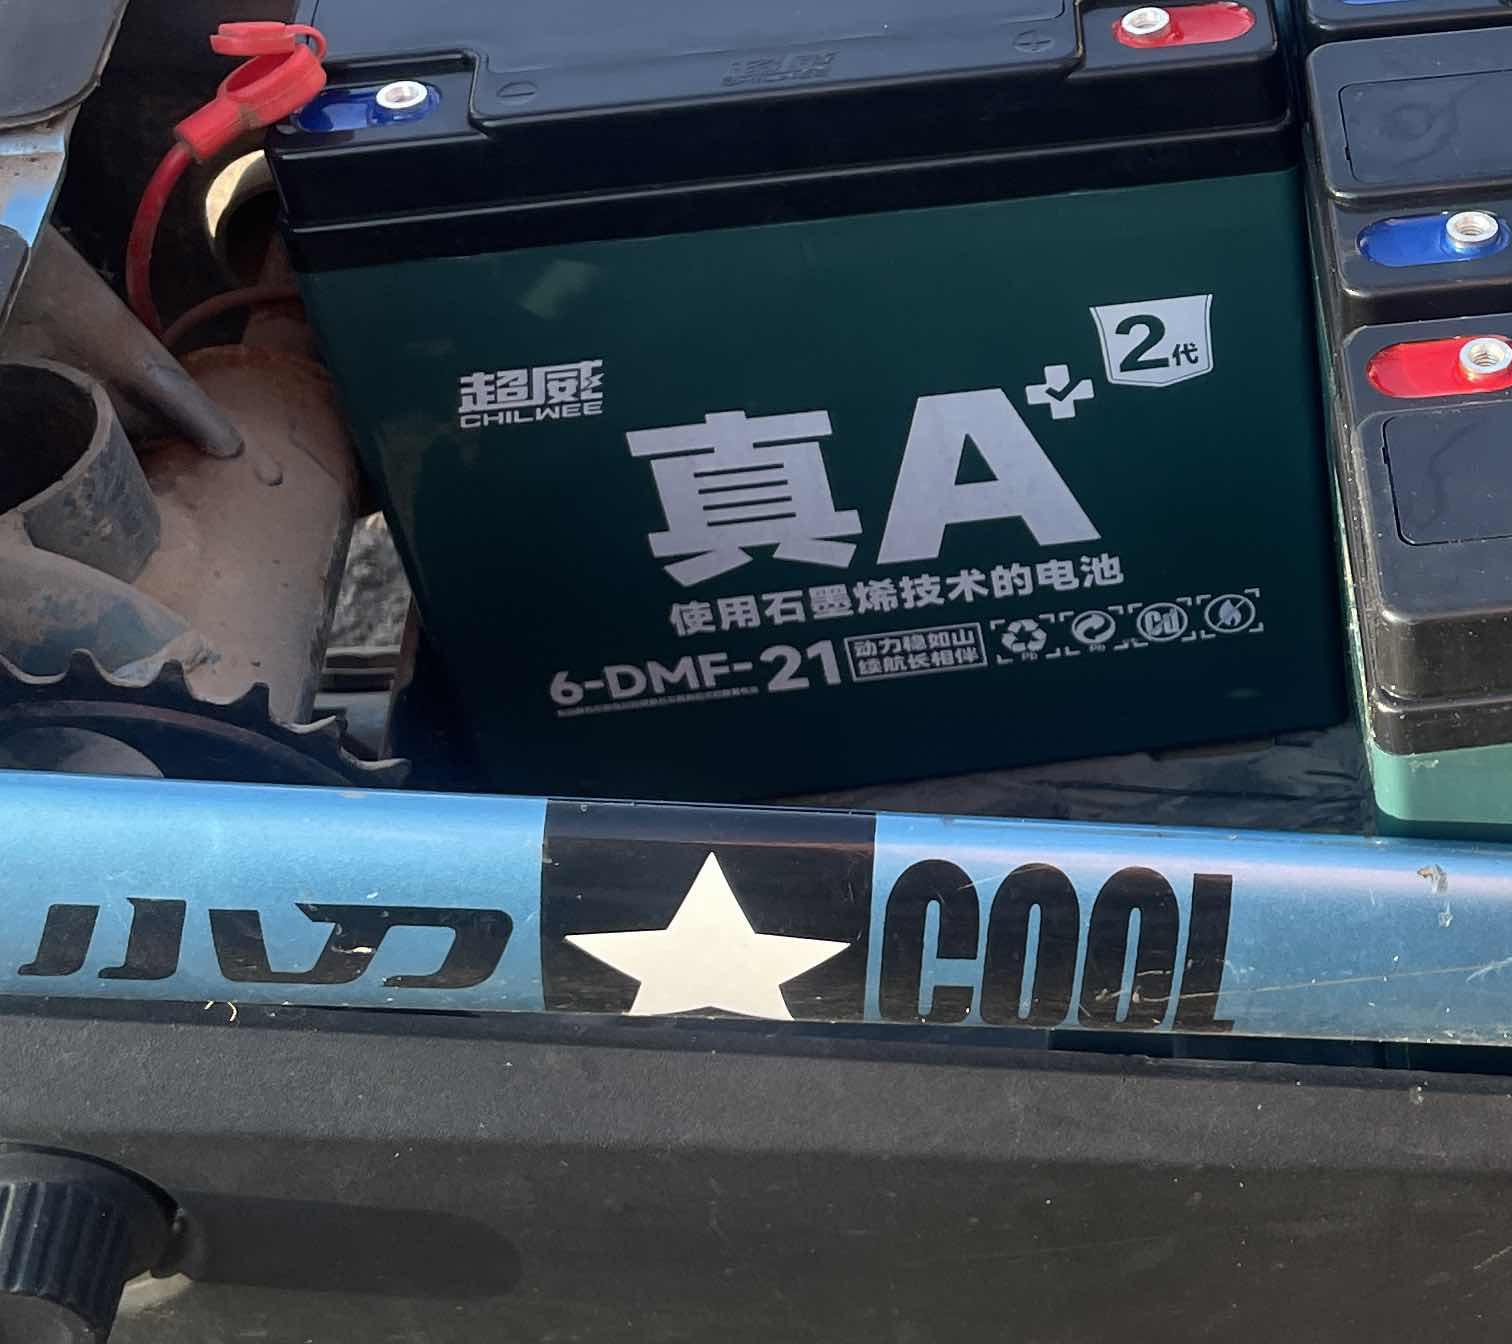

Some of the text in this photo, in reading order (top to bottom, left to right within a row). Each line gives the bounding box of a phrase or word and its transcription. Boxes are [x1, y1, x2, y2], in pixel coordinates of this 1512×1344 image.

[1115, 314, 1199, 372] 2代
[458, 359, 604, 413] 超威
[459, 400, 603, 428] CHILWEE
[669, 553, 1125, 638] 使用石墨烯技术的电池
[853, 628, 976, 658] 动力稳如山
[857, 646, 979, 677] 续航长相伴
[549, 639, 843, 706] 6-DMF-21
[879, 859, 1235, 1032] COOL
